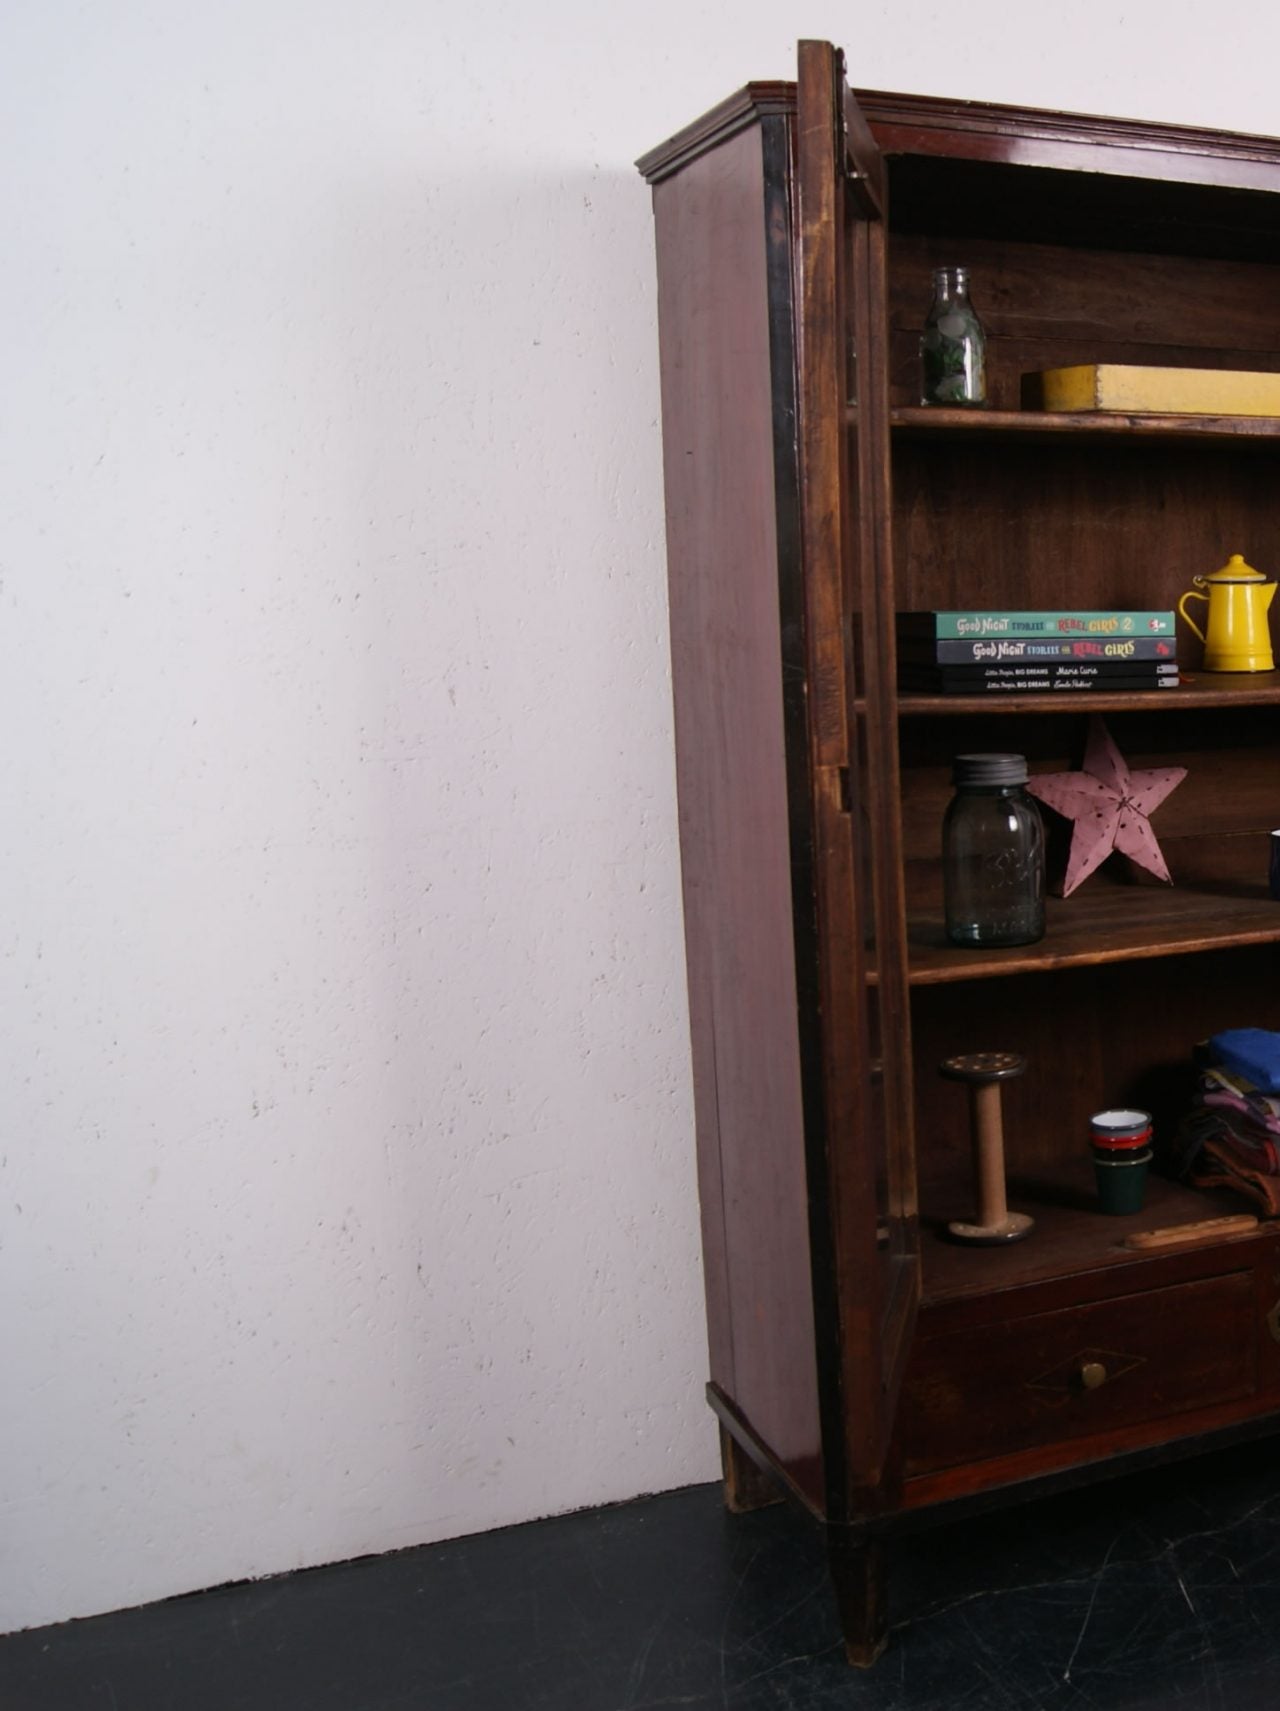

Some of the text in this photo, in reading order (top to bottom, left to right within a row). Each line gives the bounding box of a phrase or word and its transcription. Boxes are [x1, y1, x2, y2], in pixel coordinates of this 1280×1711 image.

[1012, 621, 1044, 631] STORIES
[1058, 617, 1088, 633] REBEL
[1088, 616, 1118, 633] GIRLS
[1122, 616, 1134, 632] 2
[1027, 645, 1060, 655] STORIES
[1072, 641, 1104, 658] REBEL
[1104, 639, 1135, 658] GIRLS
[1015, 668, 1025, 676] BIG
[1026, 668, 1049, 676] DREAMS
[1016, 680, 1027, 689] BIG
[1027, 680, 1051, 689] DREAMS
